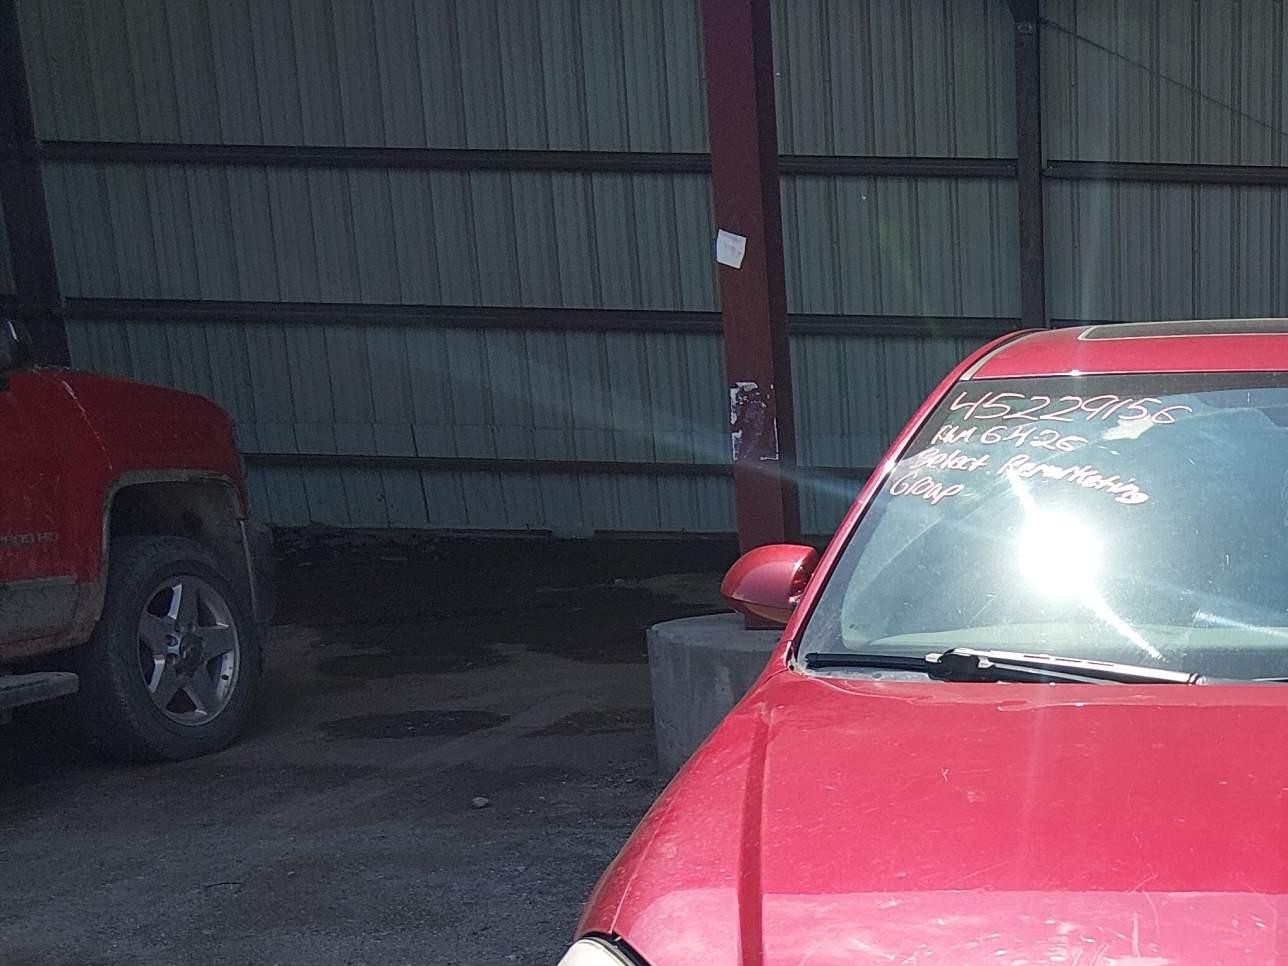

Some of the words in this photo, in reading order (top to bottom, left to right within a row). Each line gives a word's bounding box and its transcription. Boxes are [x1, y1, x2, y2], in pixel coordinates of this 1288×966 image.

[950, 391, 1193, 424] 45229156
[910, 446, 990, 472] Select
[890, 471, 964, 505] Group
